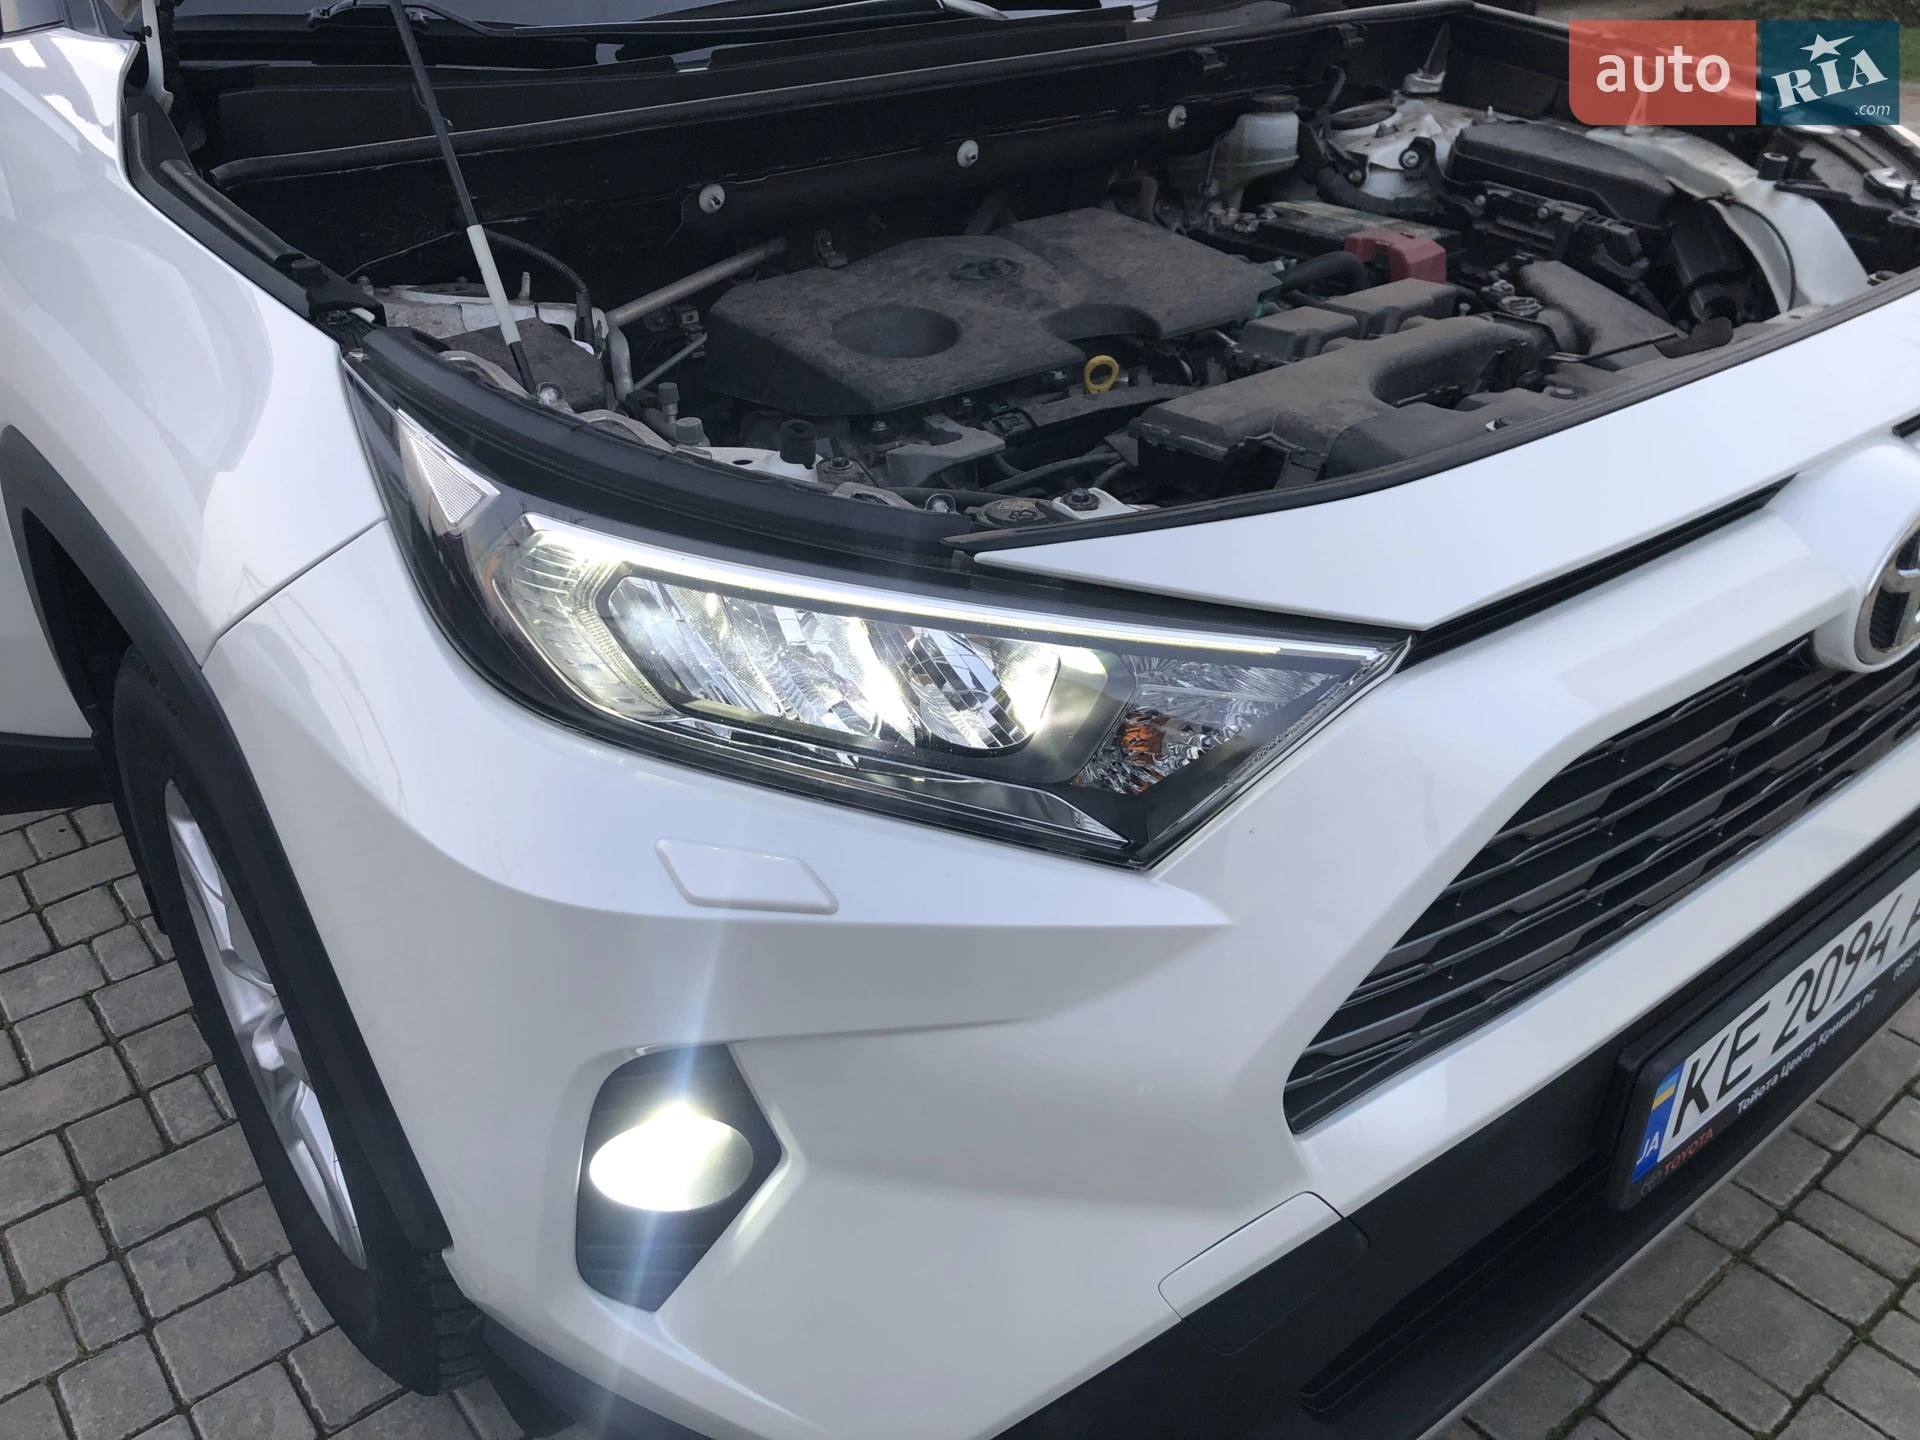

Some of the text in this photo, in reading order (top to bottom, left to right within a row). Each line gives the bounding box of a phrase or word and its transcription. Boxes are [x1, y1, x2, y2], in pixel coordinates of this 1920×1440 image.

[1672, 891, 1904, 1139] KE 2094
[1737, 1073, 1779, 1115] Тойота
[1780, 1041, 1818, 1078] Центр
[1663, 1128, 1714, 1177] TOYOTA
